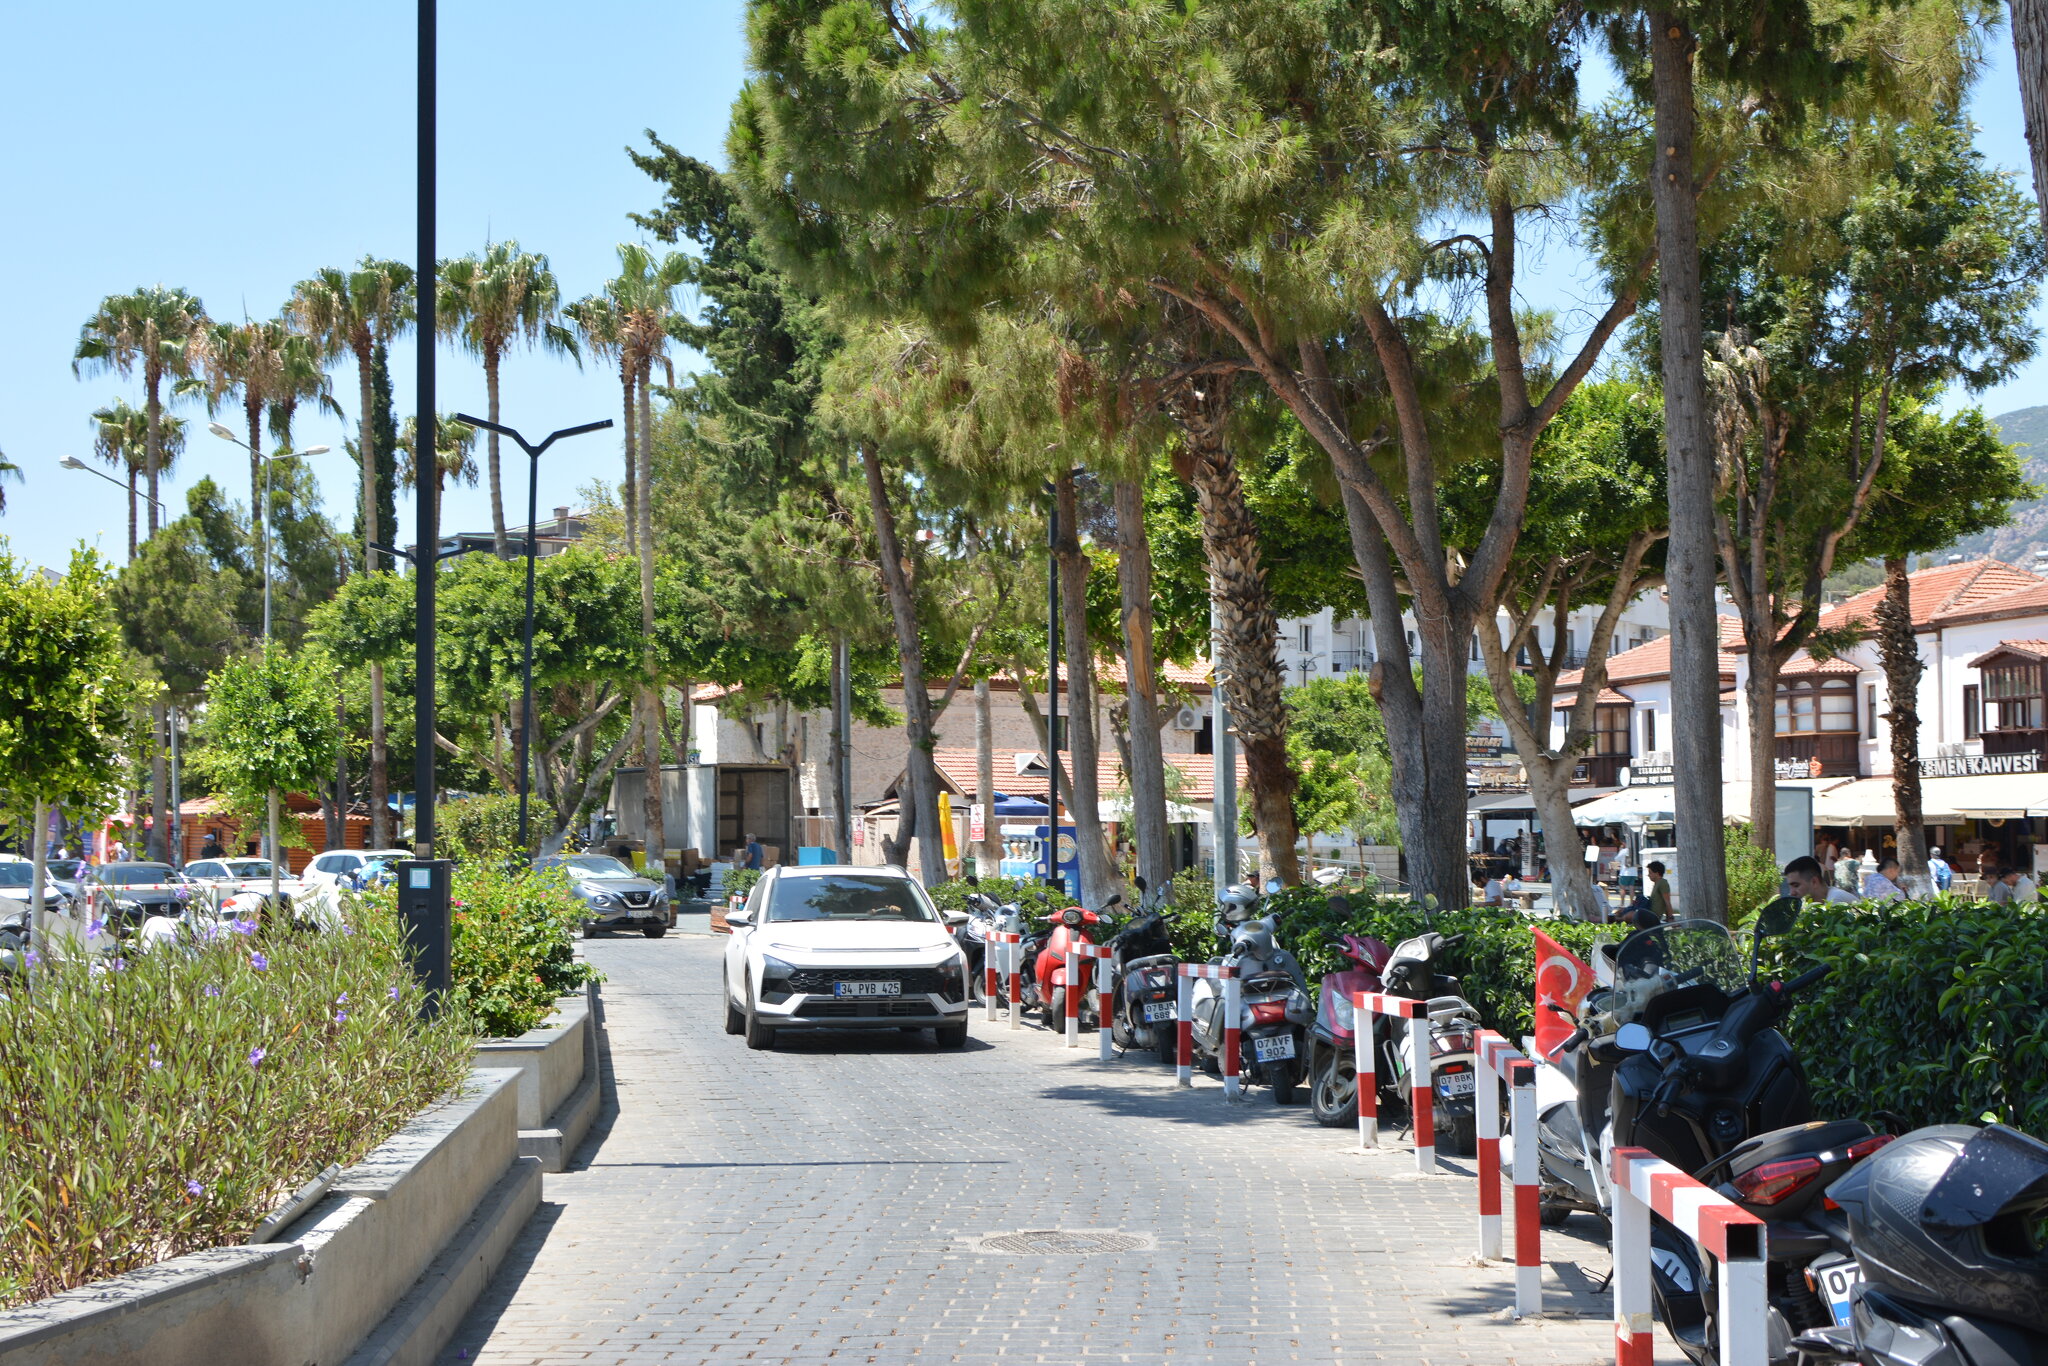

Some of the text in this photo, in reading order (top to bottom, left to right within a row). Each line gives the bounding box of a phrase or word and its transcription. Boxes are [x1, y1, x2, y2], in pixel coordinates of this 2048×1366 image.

[1970, 749, 2038, 774] KAHVESİ
[841, 983, 900, 994] 34 PVB 425
[1146, 1004, 1157, 1012] 07
[1154, 1011, 1170, 1019] 689
[1257, 1036, 1290, 1048] 07 AVF
[1266, 1046, 1287, 1057] 902
[1440, 1073, 1472, 1085] 07 BBK
[1457, 1083, 1474, 1092] 290
[1828, 1265, 1861, 1295] 07
